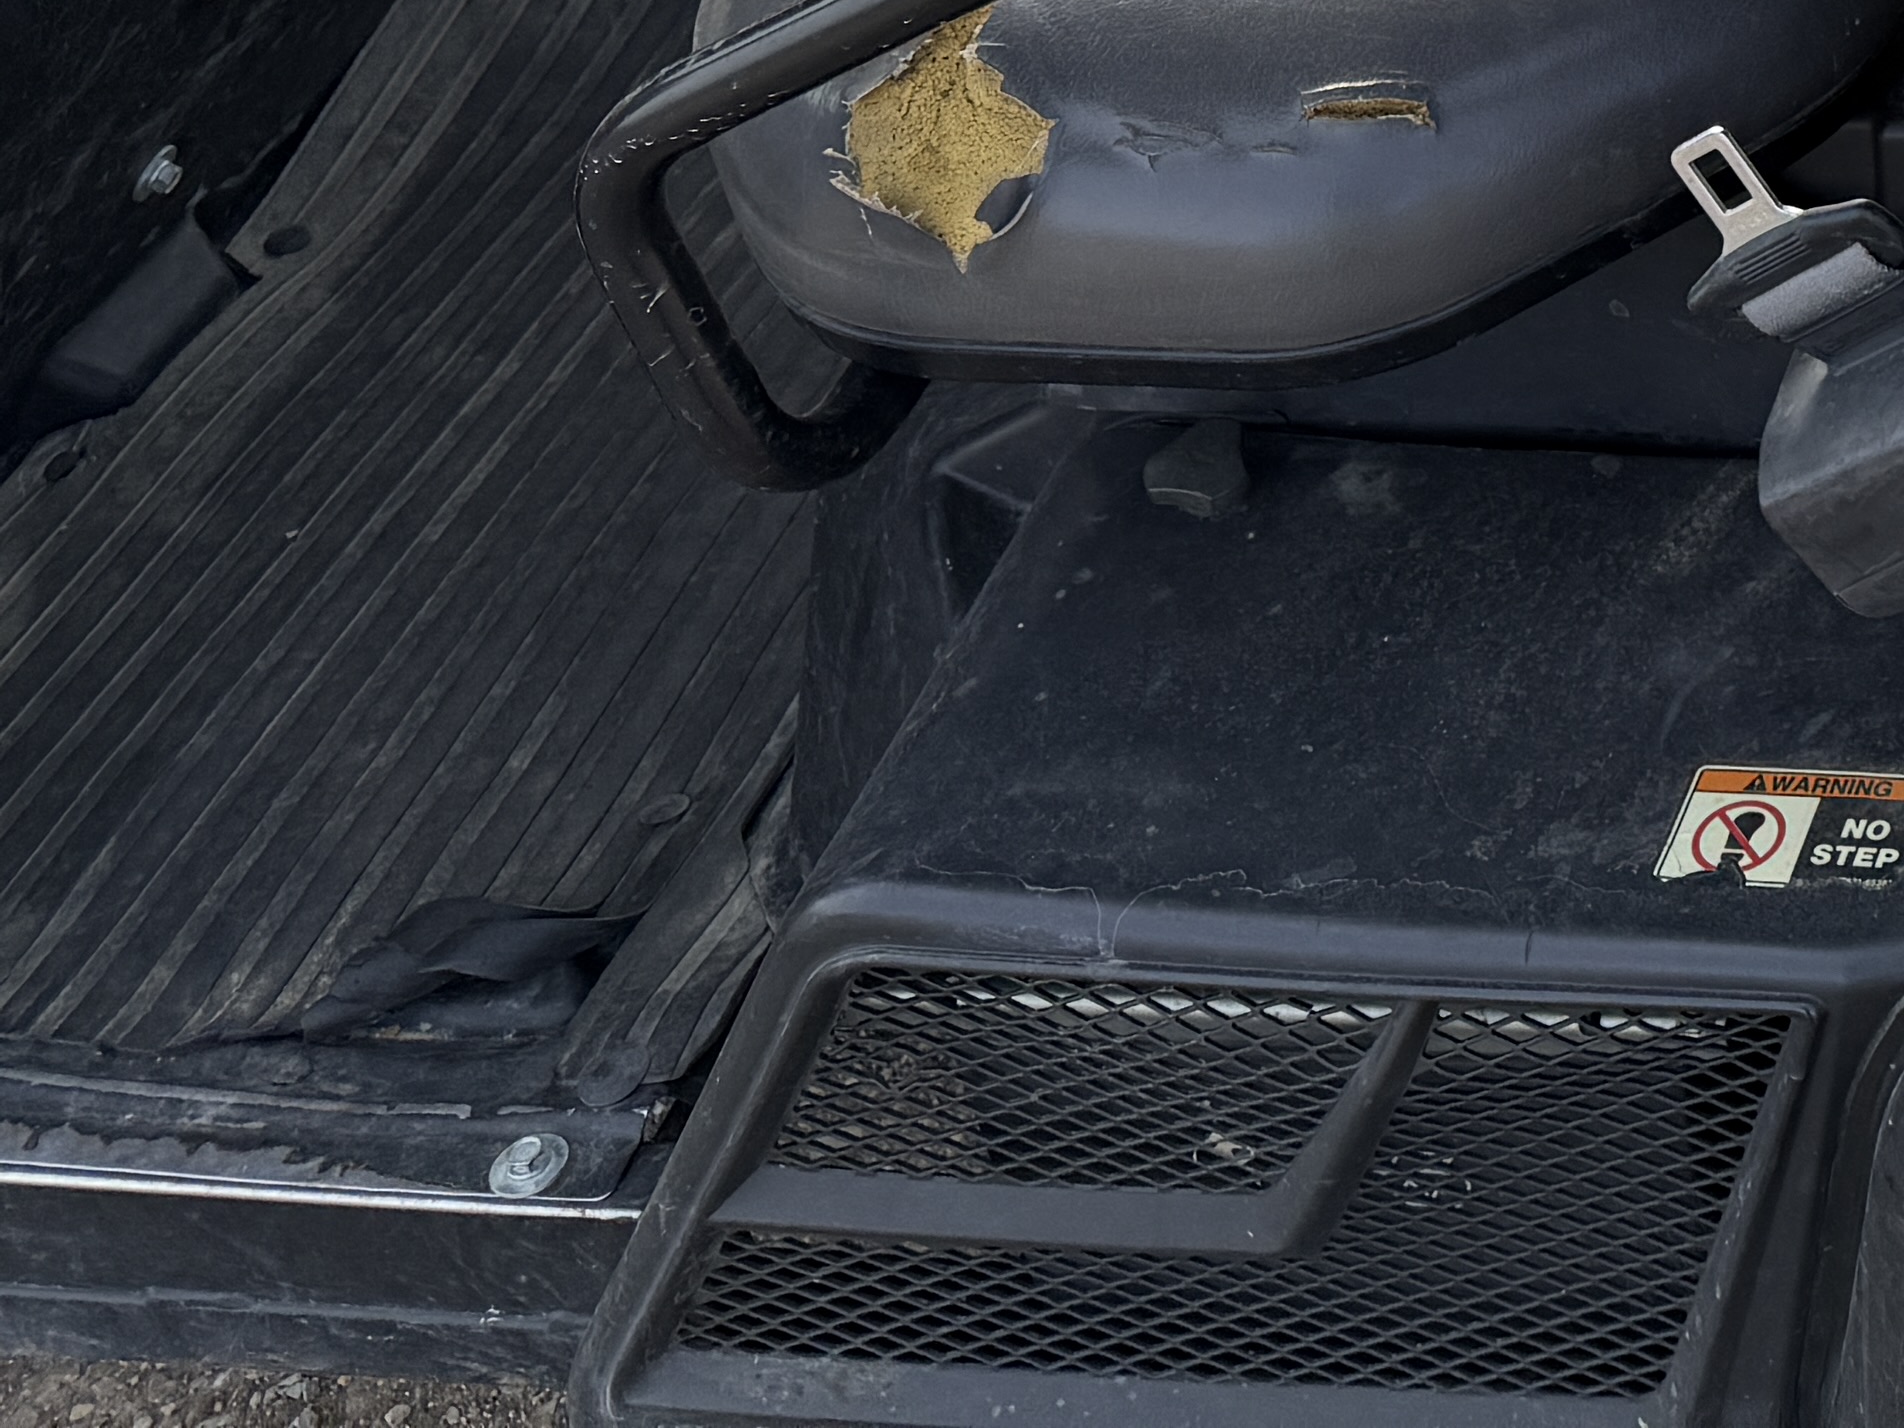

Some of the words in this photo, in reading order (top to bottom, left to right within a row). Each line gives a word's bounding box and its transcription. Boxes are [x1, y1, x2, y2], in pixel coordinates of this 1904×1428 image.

[1772, 775, 1894, 797] WARNING
[1840, 818, 1891, 841] NO
[1810, 844, 1900, 869] STEP
